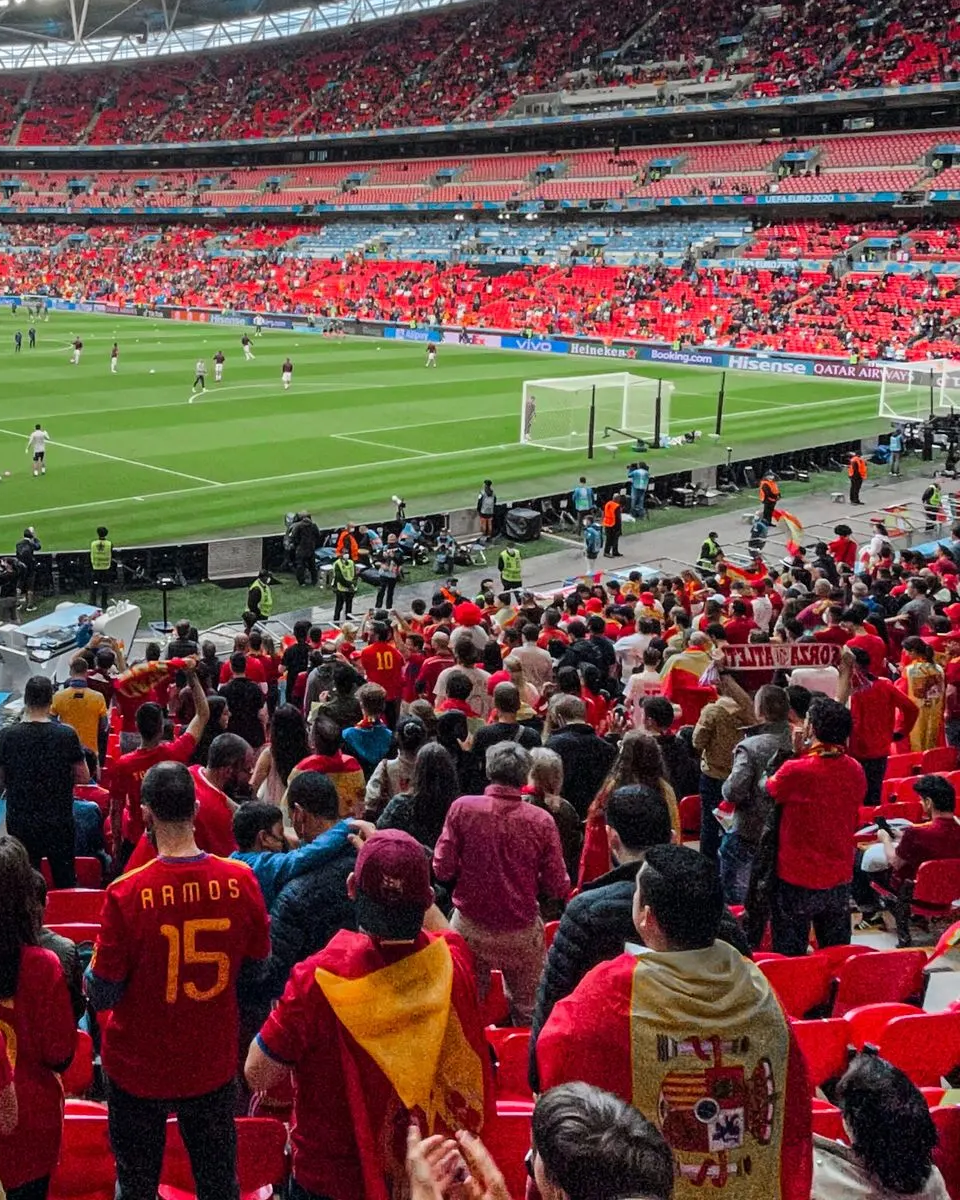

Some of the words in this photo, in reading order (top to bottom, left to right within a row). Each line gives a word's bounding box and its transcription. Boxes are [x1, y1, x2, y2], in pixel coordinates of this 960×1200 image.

[788, 195, 810, 203] EURO
[812, 194, 834, 202] 2020
[516, 339, 552, 351] vivo
[571, 343, 626, 358] Heineken
[651, 350, 712, 364] Booking.com
[729, 355, 806, 374] Hisense
[814, 363, 856, 377] QATAR
[376, 651, 393, 670] 10
[141, 879, 241, 910] RAMOS
[160, 917, 232, 1004] 15
